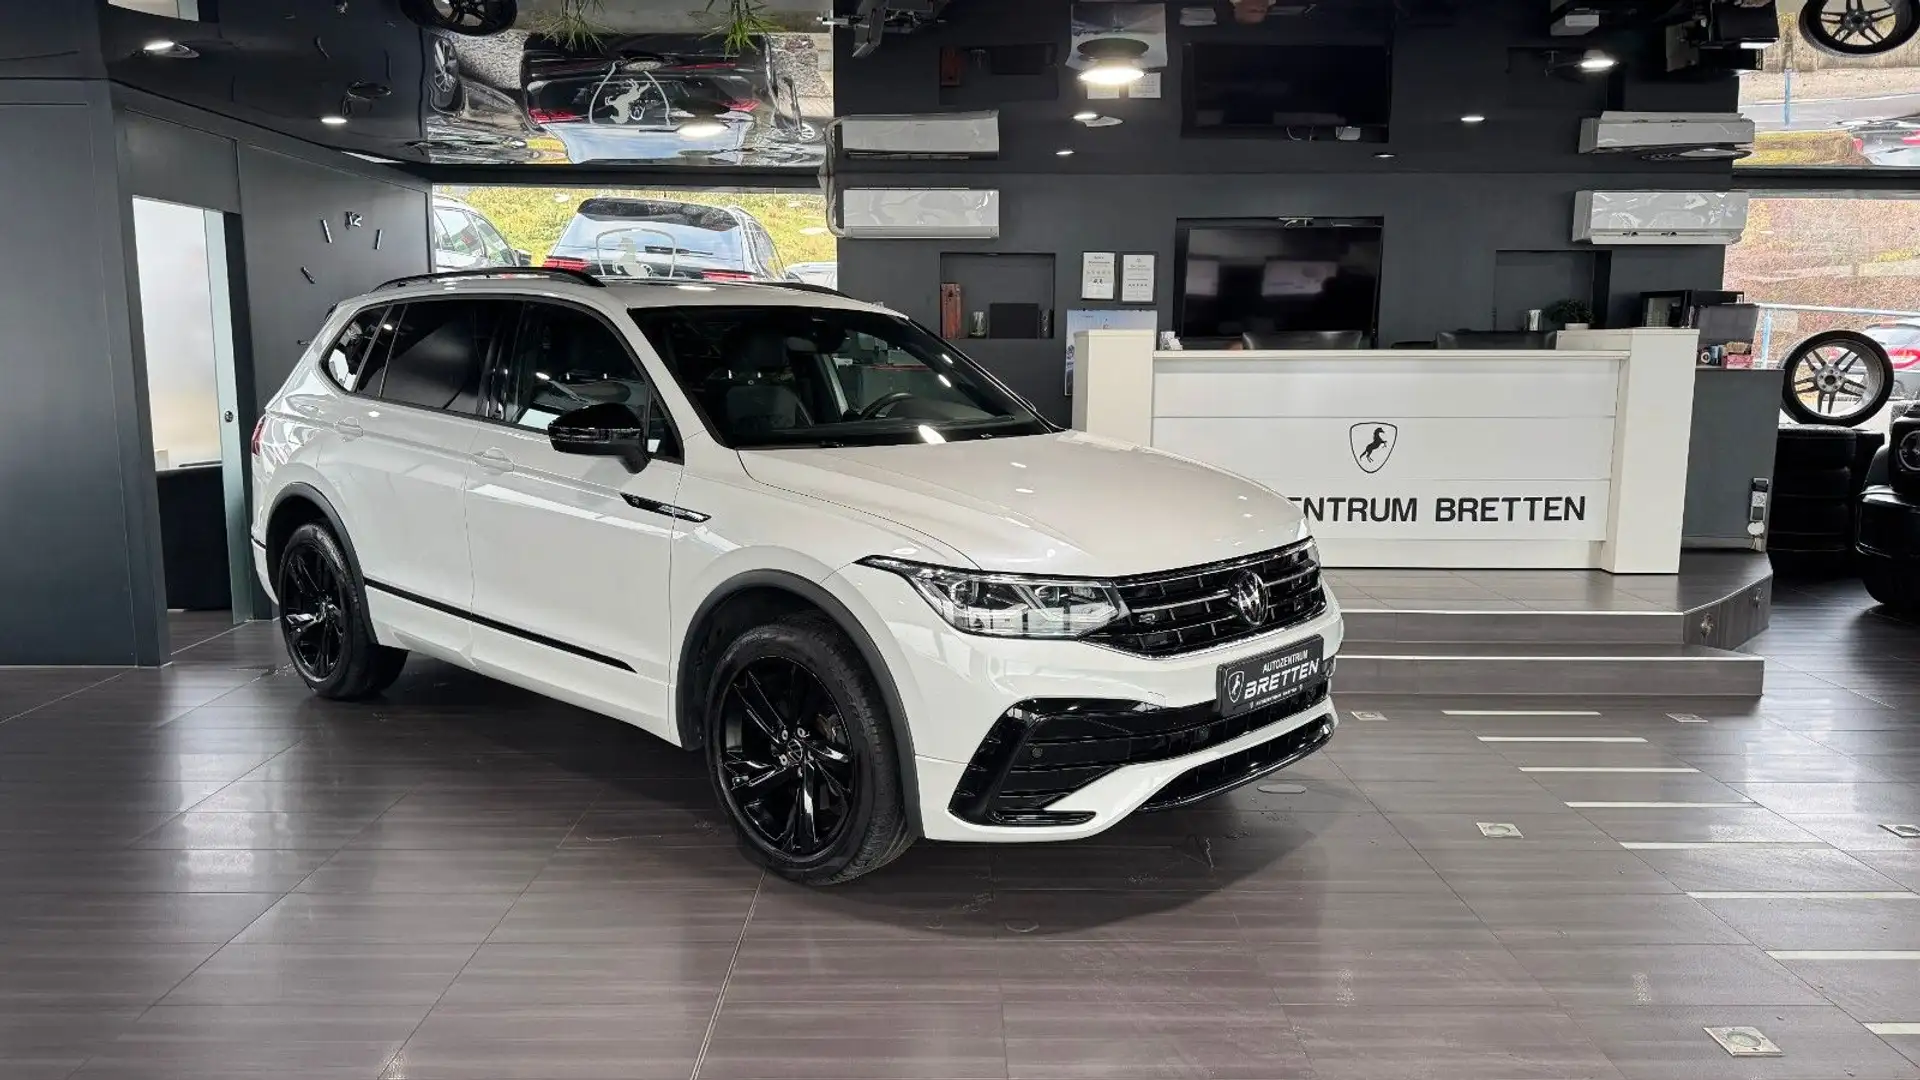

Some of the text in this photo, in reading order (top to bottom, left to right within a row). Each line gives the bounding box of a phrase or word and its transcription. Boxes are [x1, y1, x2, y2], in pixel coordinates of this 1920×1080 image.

[1435, 496, 1586, 522] BRETTEN
[1262, 649, 1309, 674] AUTOZENTRUM
[1243, 657, 1320, 700] BRETTEN
